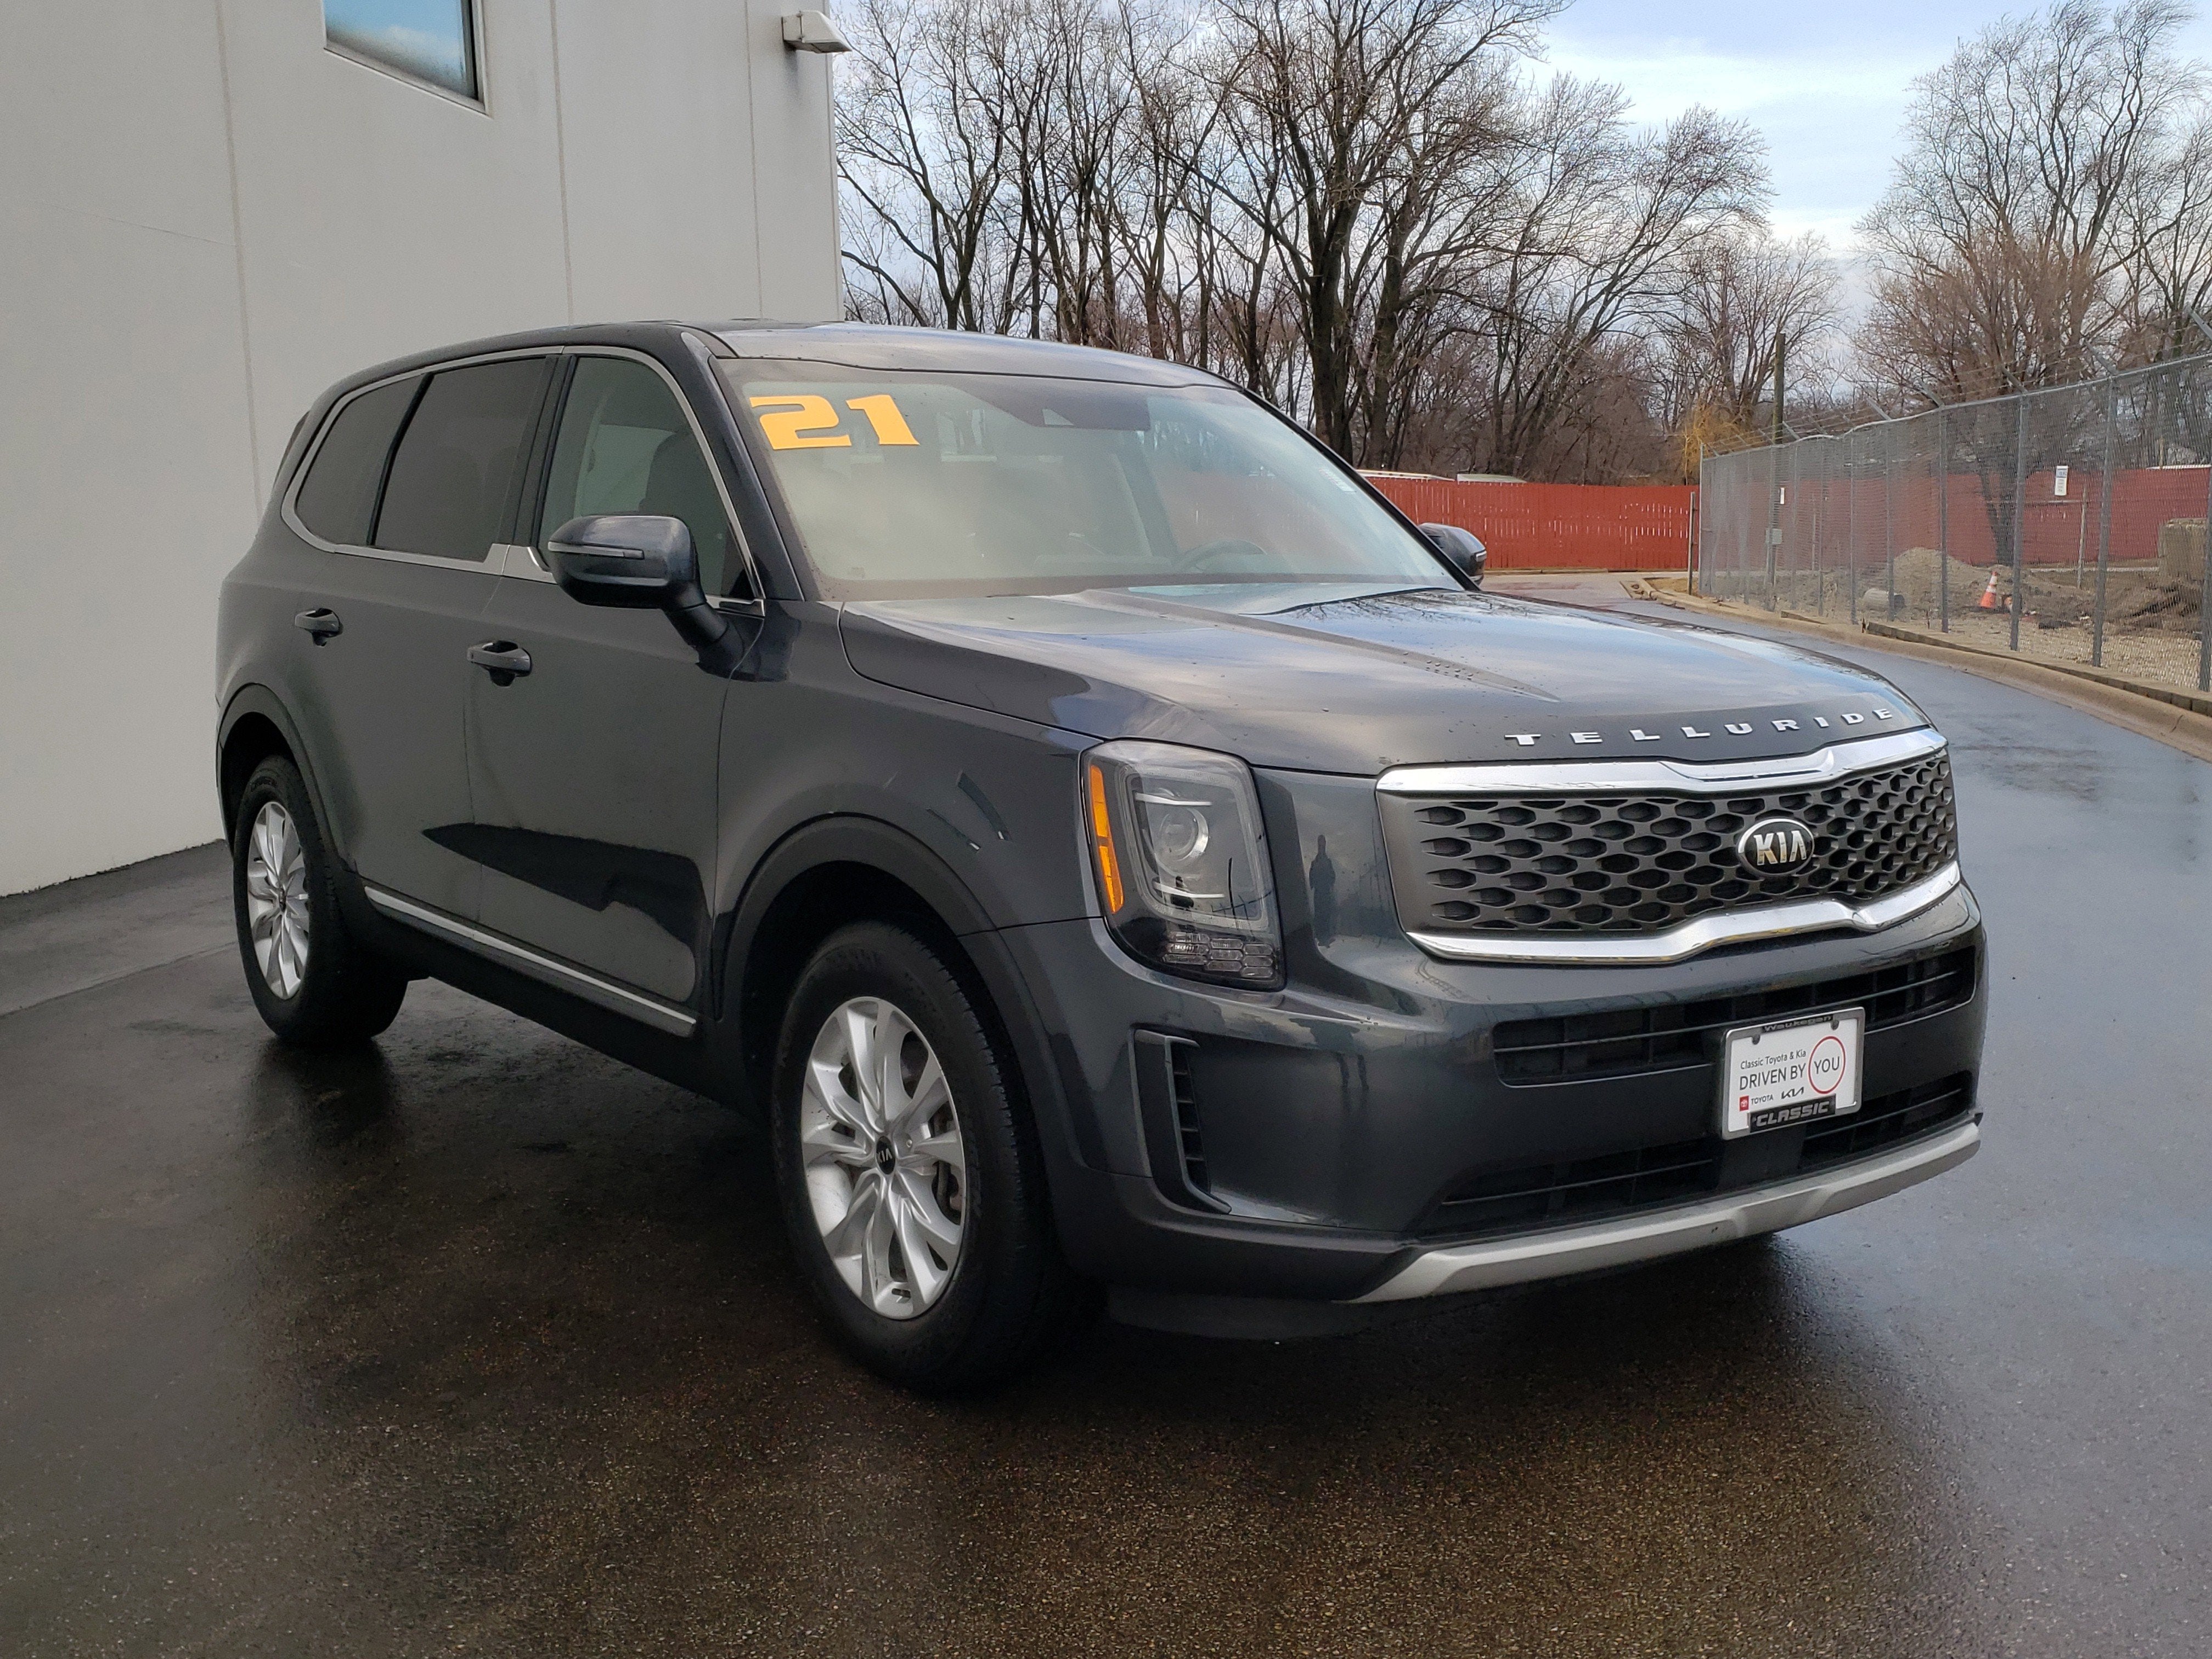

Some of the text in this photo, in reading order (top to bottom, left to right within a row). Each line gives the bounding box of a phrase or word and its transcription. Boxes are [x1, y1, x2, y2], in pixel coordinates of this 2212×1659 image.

[749, 394, 921, 450] 21
[1504, 708, 1893, 746] TELLURIDE
[1753, 829, 1807, 866] KIA
[1739, 1056, 1840, 1091] DRIVEN BY YOU
[1740, 1048, 1807, 1070] Classic Toyota & Kia
[1751, 1094, 1774, 1105] TOYOTA
[1756, 1101, 1830, 1127] CLASSIC
